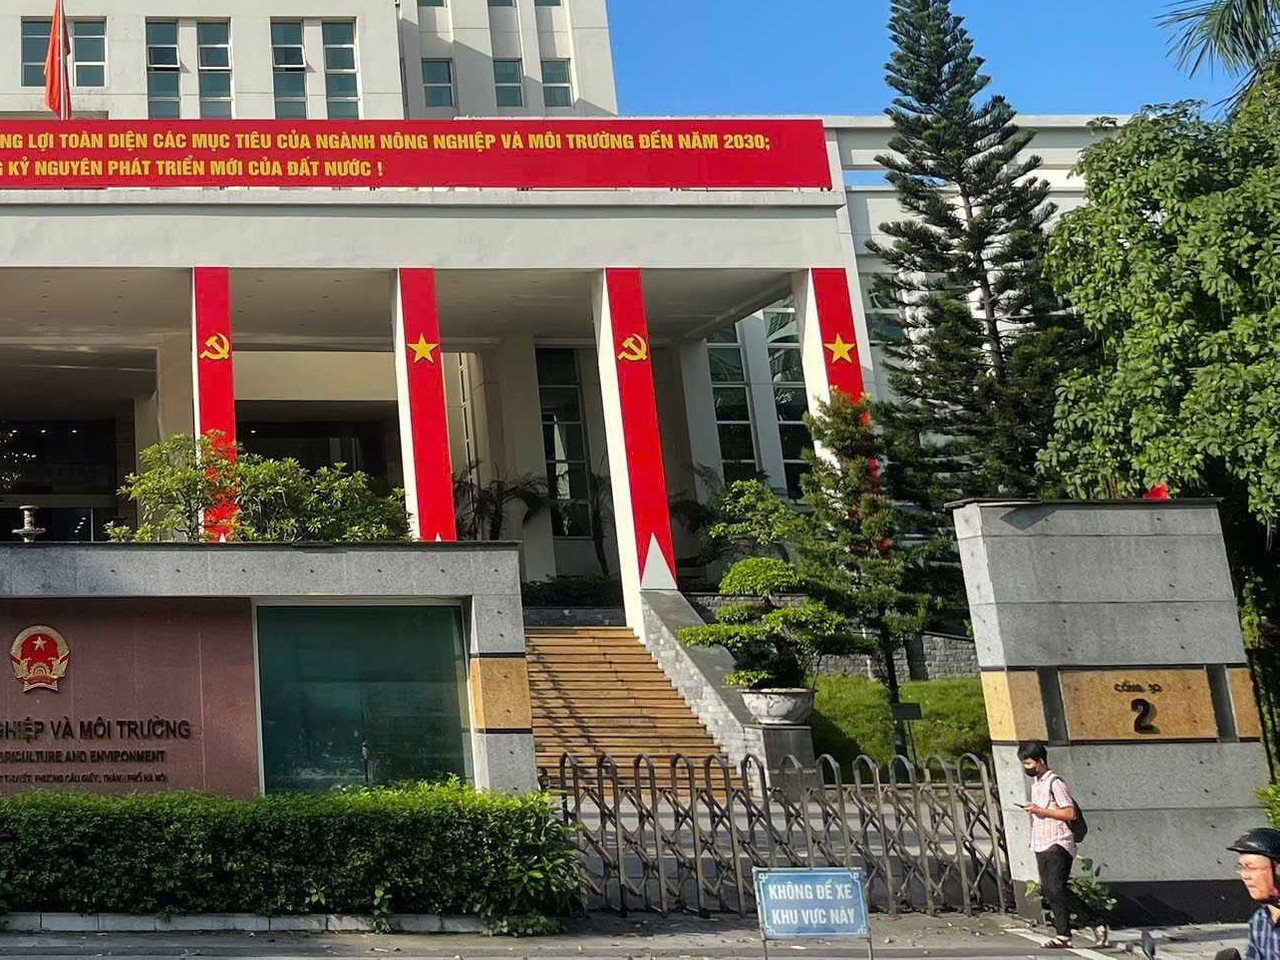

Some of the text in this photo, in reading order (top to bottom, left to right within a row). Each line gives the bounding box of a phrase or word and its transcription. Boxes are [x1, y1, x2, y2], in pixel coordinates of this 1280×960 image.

[28, 132, 54, 151] LỢI
[59, 131, 103, 148] TOÀN
[109, 131, 148, 151] DIỆN
[153, 131, 187, 148] CÁC
[192, 134, 230, 151] MỤC
[235, 131, 272, 148] TIÊU
[277, 130, 311, 149] CỦA
[316, 132, 375, 149] NGÀNH
[380, 132, 428, 149] NÔNG
[433, 132, 496, 152] NGHIỆP
[501, 132, 524, 149] VÀ
[528, 131, 561, 149] MÔI
[566, 131, 634, 149] TRƯỜNG
[639, 130, 673, 149] ĐẾN
[678, 132, 718, 149] NĂM
[723, 134, 771, 150] 2030;
[9, 156, 29, 176] KỶ
[35, 158, 102, 176] NGUYÊN
[108, 158, 151, 176] PHÁT
[156, 155, 204, 176] TRIỂN
[210, 158, 242, 176] MỚI
[248, 156, 282, 176] CỦA
[287, 156, 319, 176] ĐẤT
[324, 158, 372, 176] NƯỚC
[1131, 698, 1161, 735] 2
[50, 716, 74, 740] VÀ
[80, 716, 112, 740] MÔI
[116, 715, 191, 740] TRƯỜNG
[65, 751, 87, 764] AND
[90, 750, 166, 764] ENVIRONMENT
[768, 882, 814, 900] KHÔNG
[835, 883, 853, 899] XE
[772, 907, 856, 927] KHU VỰC NÀY
